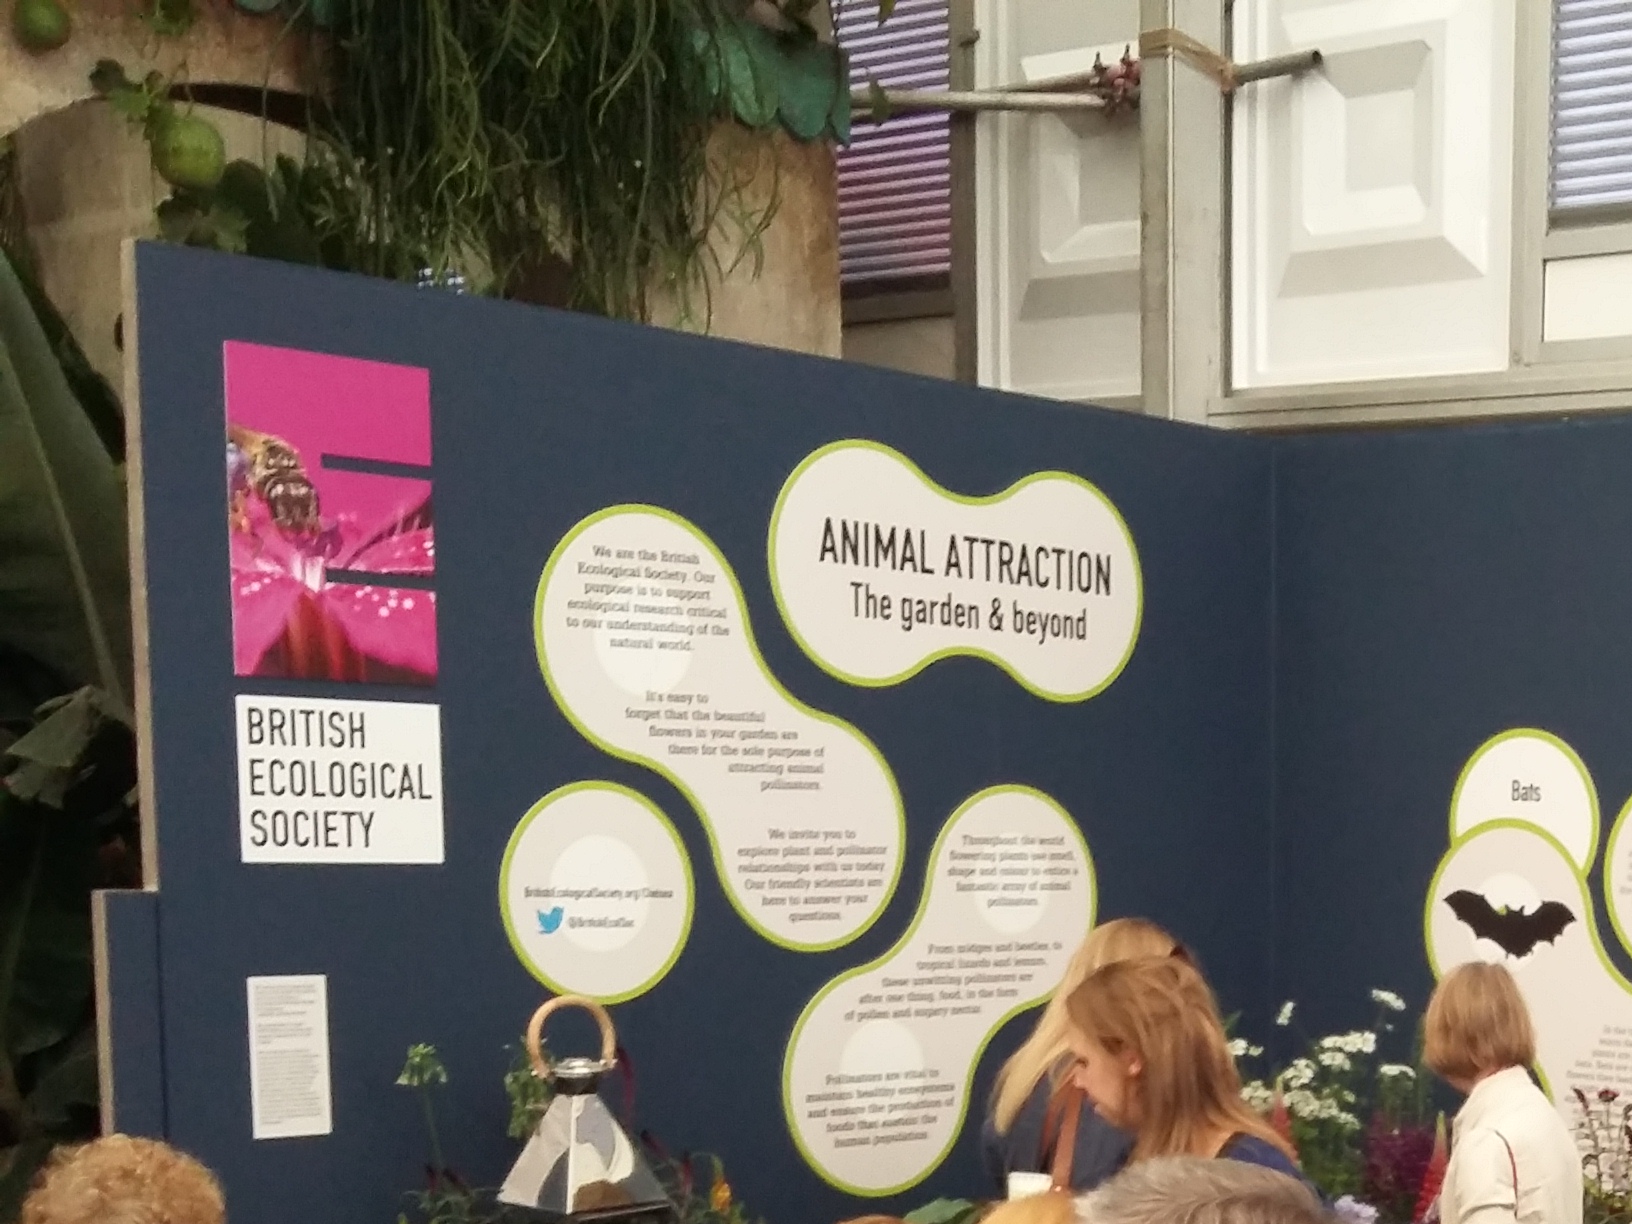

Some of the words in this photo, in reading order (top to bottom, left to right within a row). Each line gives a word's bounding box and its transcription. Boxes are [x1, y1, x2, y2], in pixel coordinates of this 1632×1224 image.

[593, 545, 611, 558] We
[616, 549, 634, 559] are
[638, 548, 657, 560] the
[661, 550, 700, 564] British
[819, 517, 936, 575] ANIMAL
[944, 534, 1112, 596] ATTRACTION
[578, 562, 640, 578] Ecological
[694, 571, 715, 583] Our
[584, 583, 633, 595] purpose
[637, 585, 647, 596] is
[650, 587, 662, 597] to
[666, 588, 710, 600] support
[567, 600, 629, 613] ecological
[634, 604, 683, 615] research
[686, 606, 727, 619] critical
[850, 582, 892, 620] The
[901, 593, 980, 632] garden
[988, 598, 1003, 632] &
[1012, 600, 1087, 645] beyond
[566, 617, 579, 628] to
[582, 618, 602, 629] our
[606, 620, 694, 636] understanding
[696, 624, 708, 635] of
[711, 625, 730, 636] the
[610, 638, 653, 649] natural
[667, 693, 694, 705] easy
[697, 693, 709, 703] to
[625, 707, 661, 721] forget
[664, 709, 688, 720] that
[692, 709, 710, 721] the
[714, 710, 766, 722] beautiful
[248, 707, 366, 748] BRITISH
[649, 725, 692, 737] flowers
[711, 728, 736, 739] your
[739, 729, 778, 741] garden
[668, 744, 699, 755] there
[702, 744, 718, 756] for
[720, 744, 738, 756] the
[767, 747, 811, 759] purpose
[728, 763, 783, 775] attracting
[250, 759, 433, 800] ECOLOGICAL
[1511, 780, 1542, 802] Bats
[250, 810, 376, 848] SOCIETY
